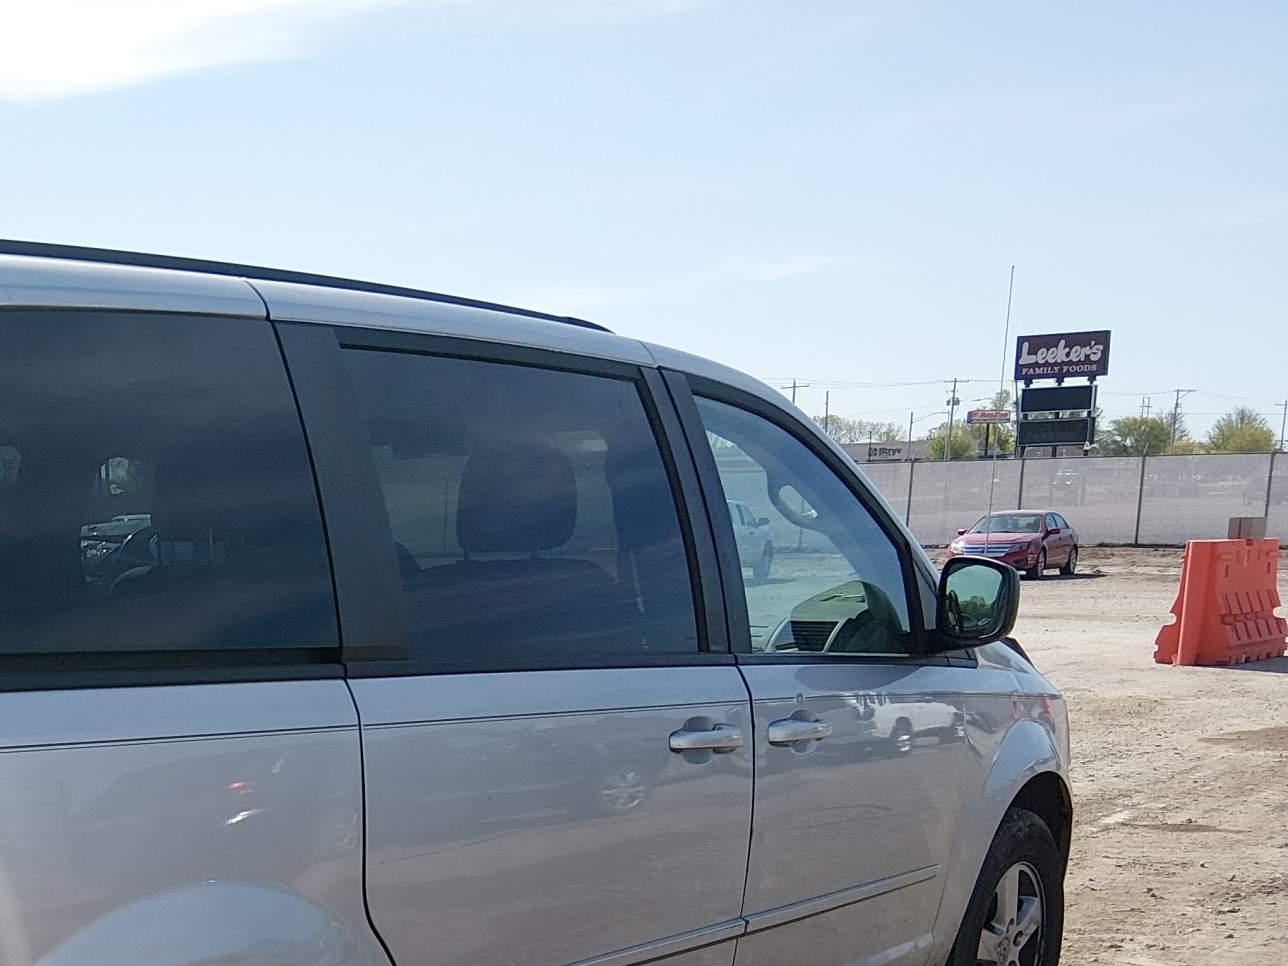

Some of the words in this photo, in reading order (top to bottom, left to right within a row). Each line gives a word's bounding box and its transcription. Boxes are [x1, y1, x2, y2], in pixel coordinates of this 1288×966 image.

[1018, 339, 1104, 365] Leeker's
[1021, 365, 1060, 376] FAMILY
[1062, 364, 1097, 374] FOODS
